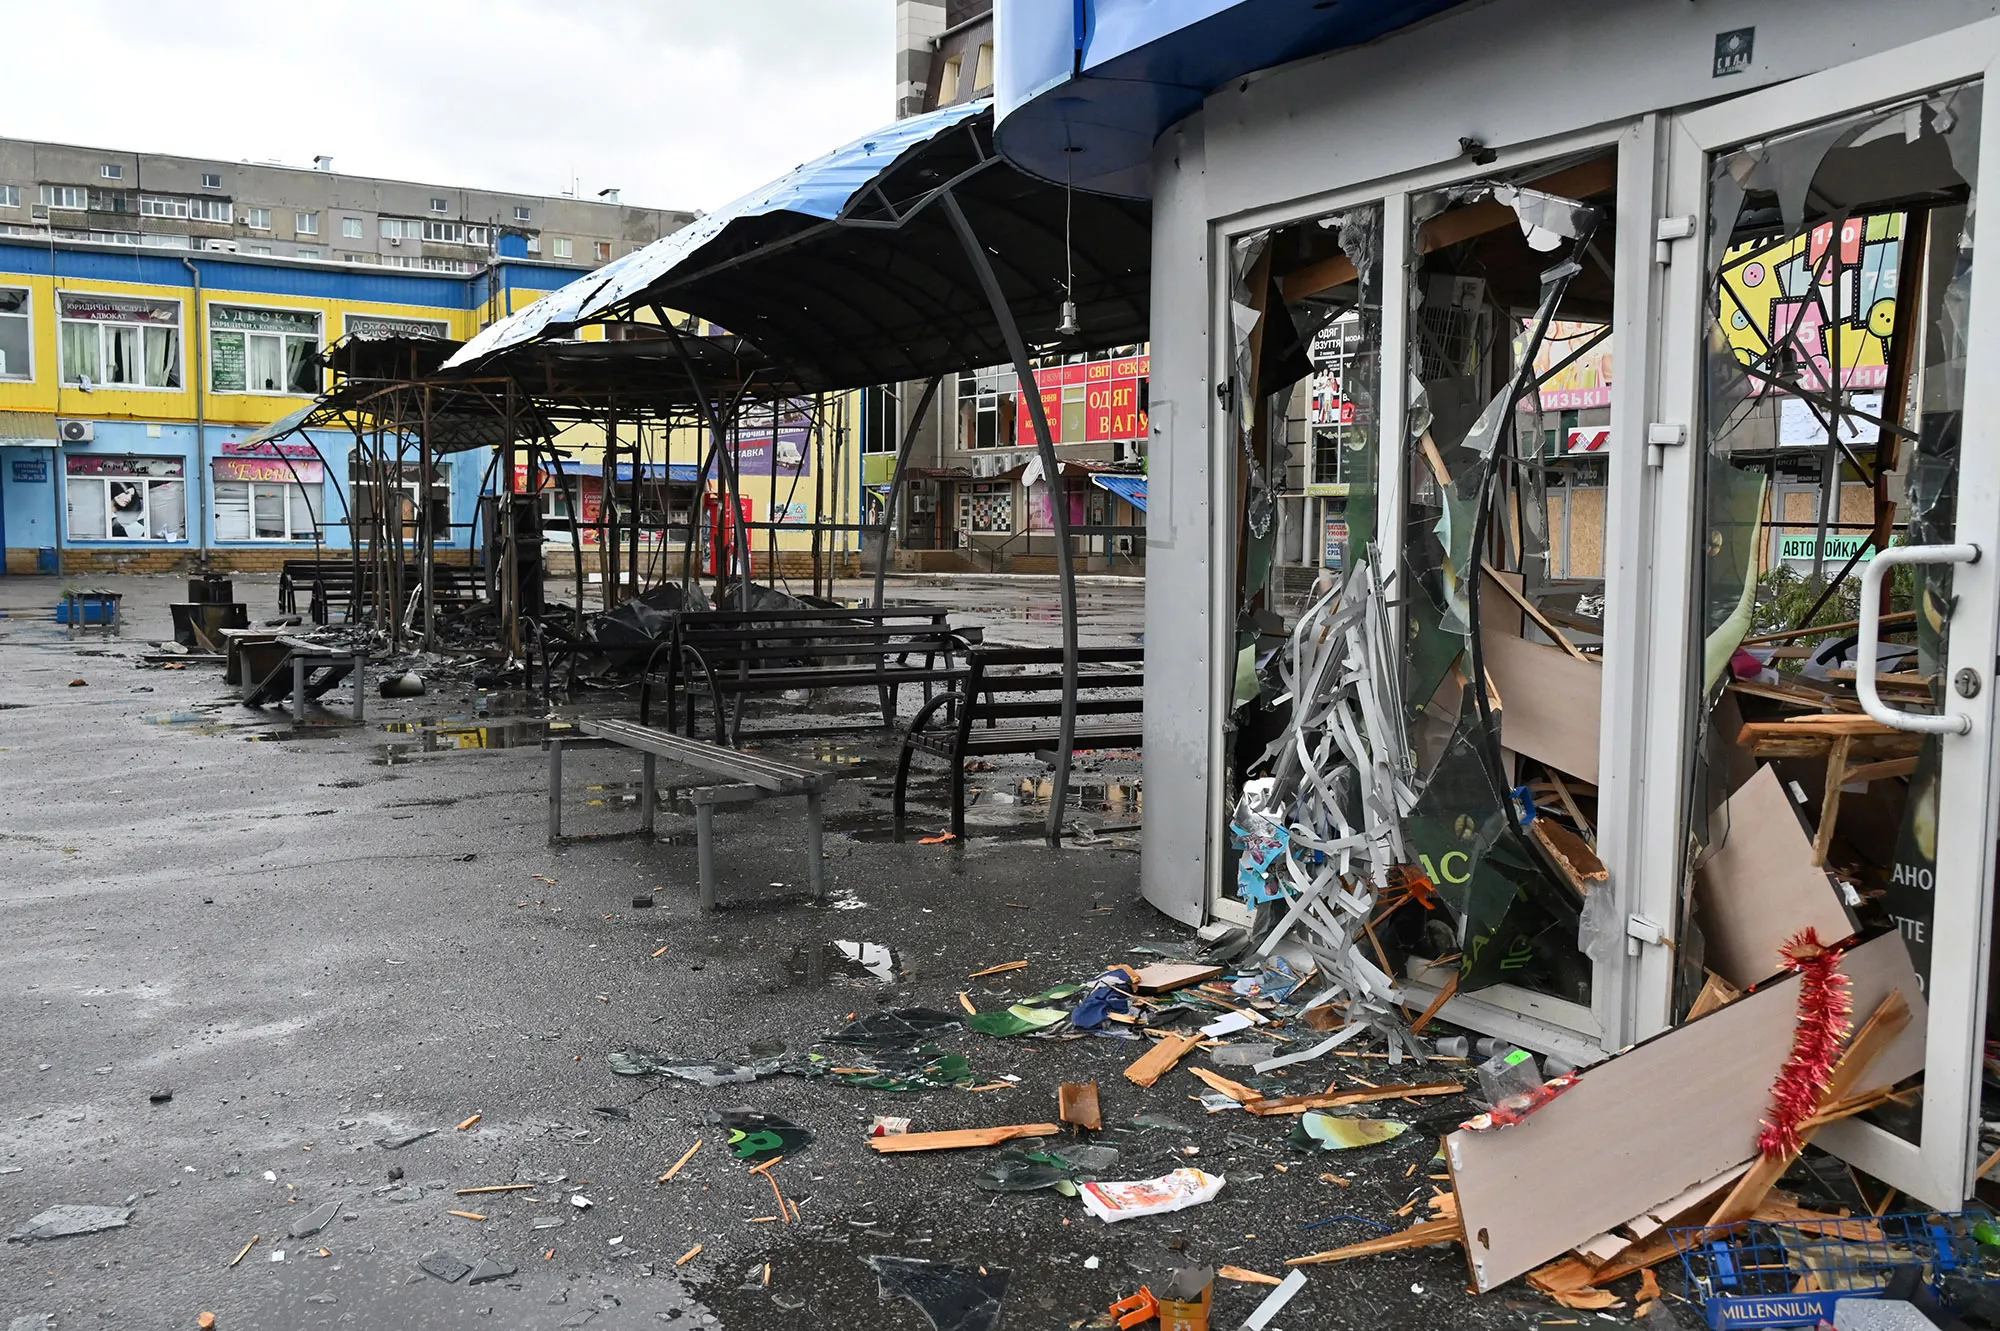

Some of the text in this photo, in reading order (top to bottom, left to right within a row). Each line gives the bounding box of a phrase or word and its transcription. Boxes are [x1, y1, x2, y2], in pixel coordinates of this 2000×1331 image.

[1865, 269, 1898, 290] 75
[67, 303, 111, 312] ЮРИДИЧНІ
[90, 312, 127, 320] АДВОКАТ
[1318, 327, 1339, 339] ОДЯГ
[1314, 339, 1341, 350] ВЗУТТЯ
[1089, 364, 1111, 379] СВІТ
[1089, 387, 1132, 409] ОДЯГ
[1100, 413, 1149, 434] ВАГУ
[1783, 538, 1859, 558] АВТООЙКА
[1888, 913, 1925, 943] ТТЕ
[1722, 1302, 1824, 1320] MILLENNIUM
